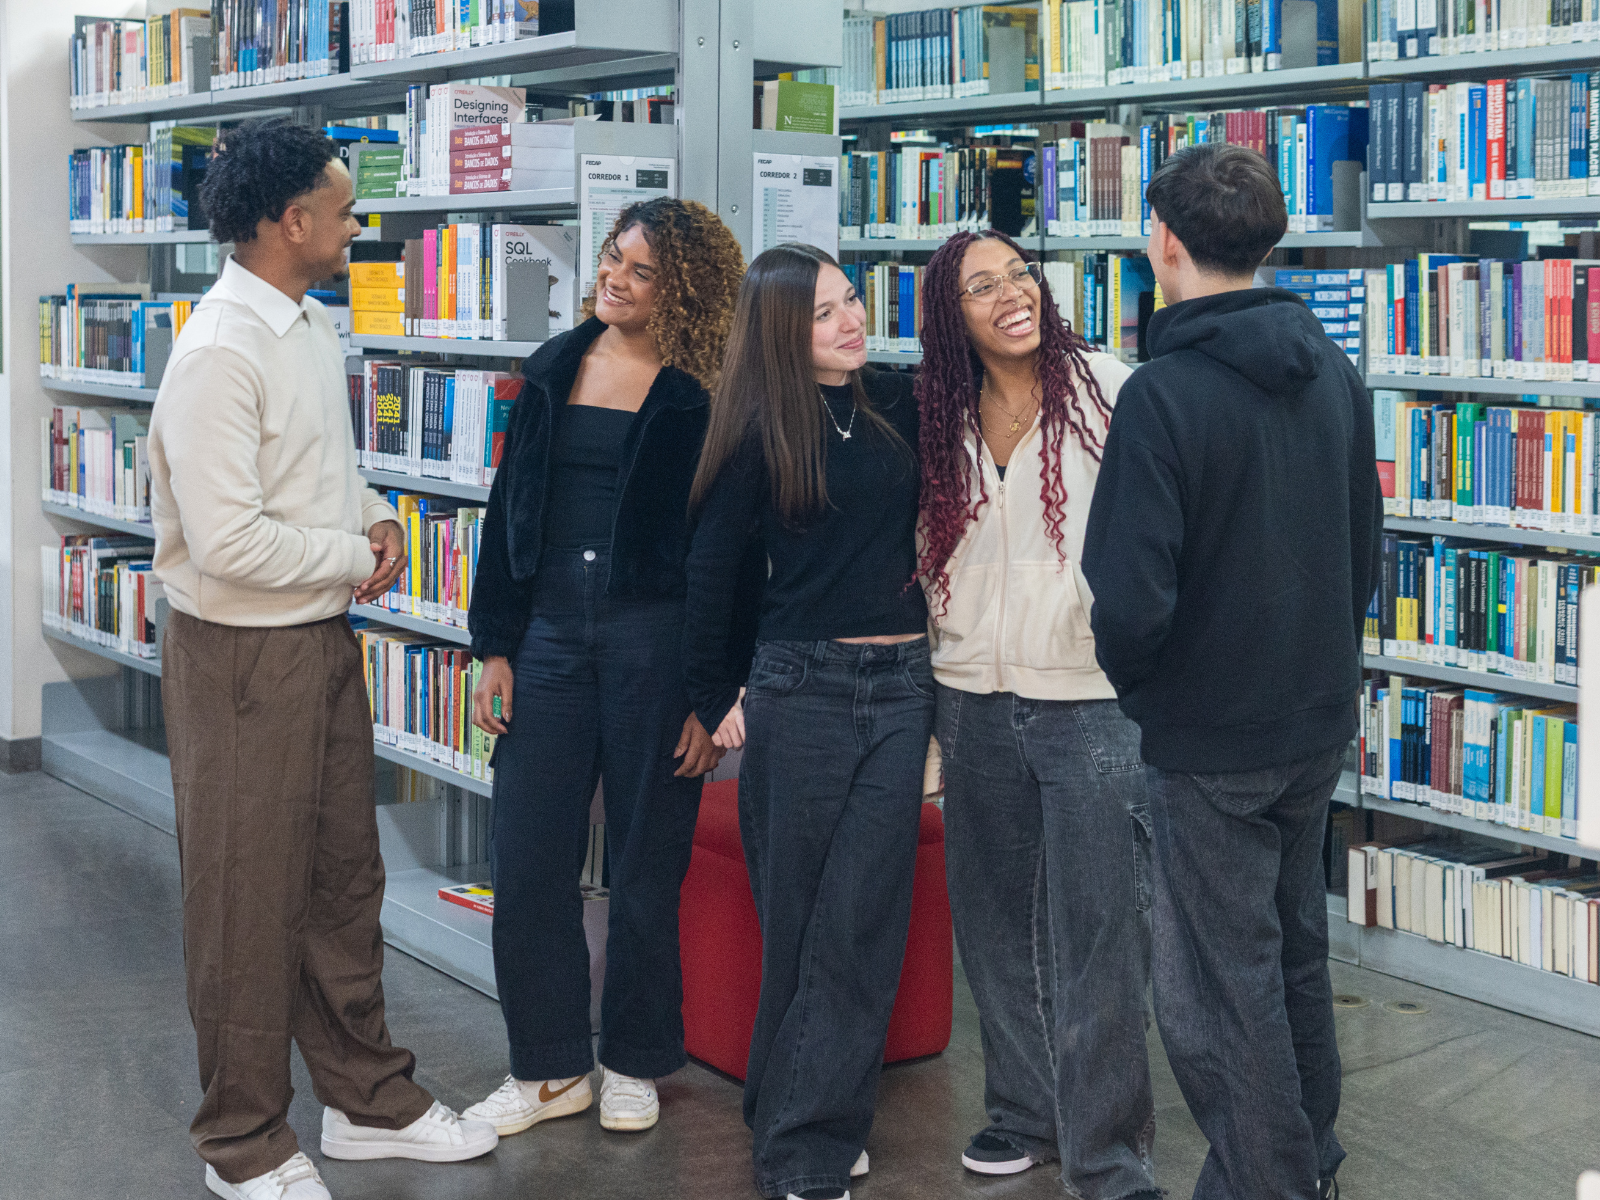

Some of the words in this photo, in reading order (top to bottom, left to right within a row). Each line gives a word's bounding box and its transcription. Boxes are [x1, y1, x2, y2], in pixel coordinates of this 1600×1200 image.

[454, 98, 508, 114] Designing
[1495, 84, 1503, 138] INDUSTRIAL
[454, 112, 508, 124] Interfaces
[1590, 90, 1599, 140] MARKETING
[464, 137, 479, 146] BANCOS
[484, 134, 498, 143] DADOS
[464, 159, 479, 168] BANCOS
[485, 156, 498, 166] DADOS
[1590, 142, 1599, 176] PLACES
[588, 172, 621, 181] CORREDOR
[464, 180, 479, 190] BANCOS
[484, 178, 498, 188] DADOS
[506, 241, 532, 255] SQL
